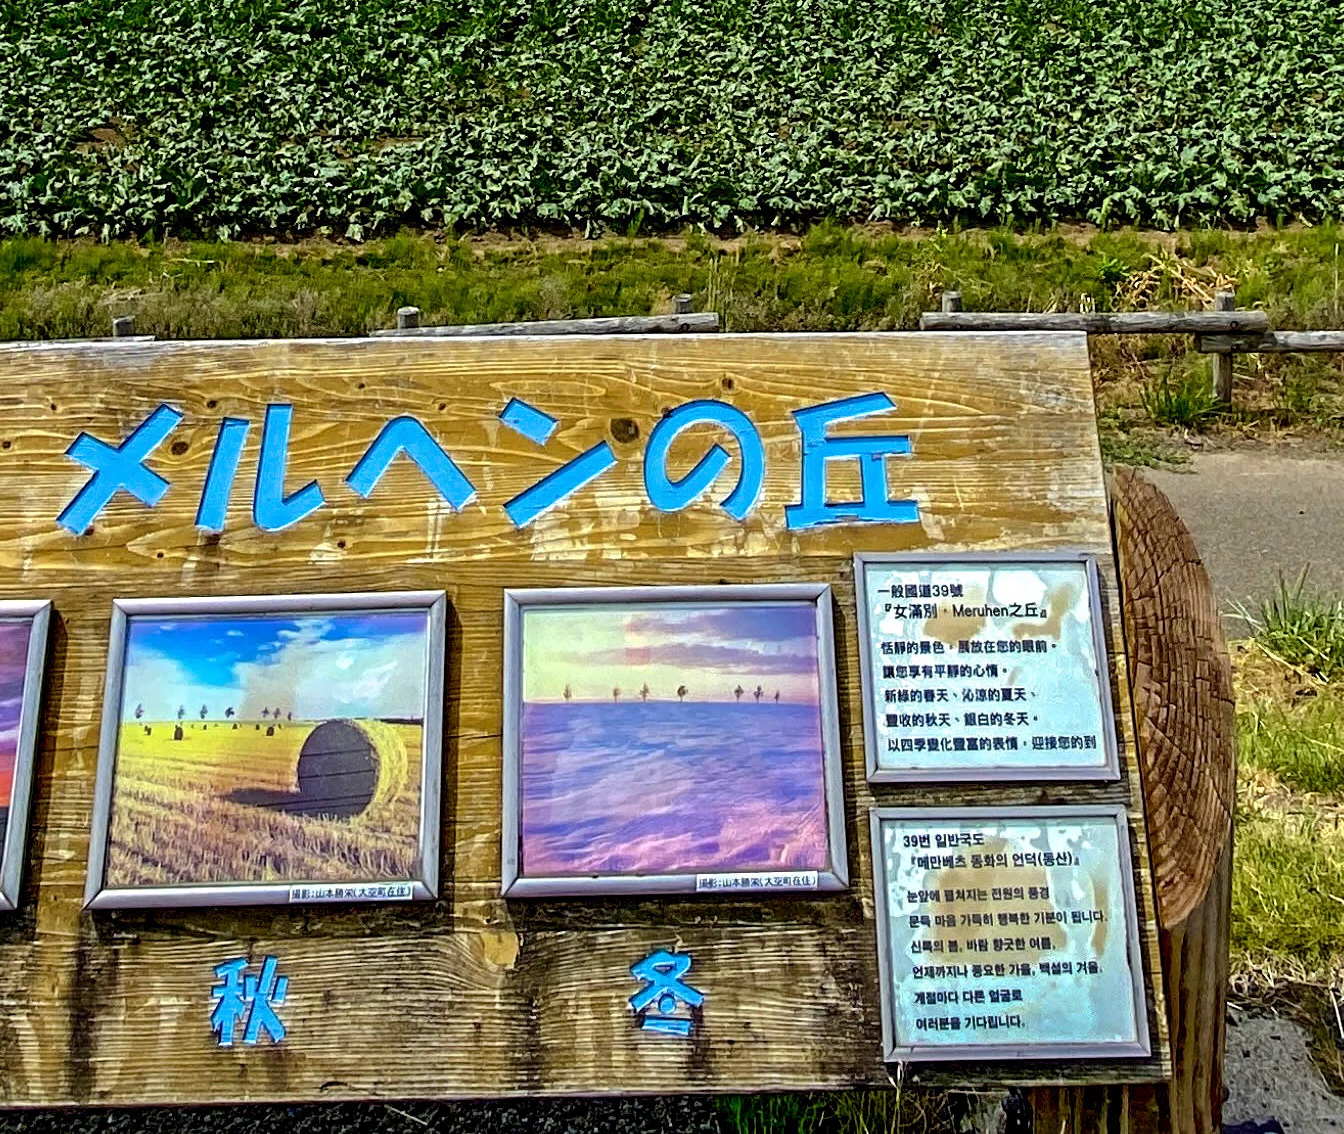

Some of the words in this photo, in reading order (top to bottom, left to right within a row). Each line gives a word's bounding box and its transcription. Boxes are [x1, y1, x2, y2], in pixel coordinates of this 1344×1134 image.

[56, 391, 922, 535] メルヘンの丘
[877, 584, 964, 598] 一般國道39號
[903, 833, 931, 848] 39번
[935, 832, 986, 848] 일반국도
[970, 853, 1008, 869] 동화의
[991, 887, 1025, 901] 전원의
[1028, 886, 1050, 900] 풍경
[934, 914, 957, 928] 마음
[997, 912, 1031, 926] 행복한
[1034, 911, 1068, 925] 기분이
[966, 938, 989, 952] 바람
[992, 937, 1026, 952] 향긋한
[971, 963, 1006, 978] 풍요한
[1039, 961, 1073, 976] 백설의
[628, 946, 707, 1037] 冬
[914, 991, 959, 1005] 계절마다
[962, 990, 986, 1004] 다른
[988, 989, 1024, 1004] 얼굴로
[209, 953, 290, 1048] 秋
[915, 1016, 961, 1031] 여러분을
